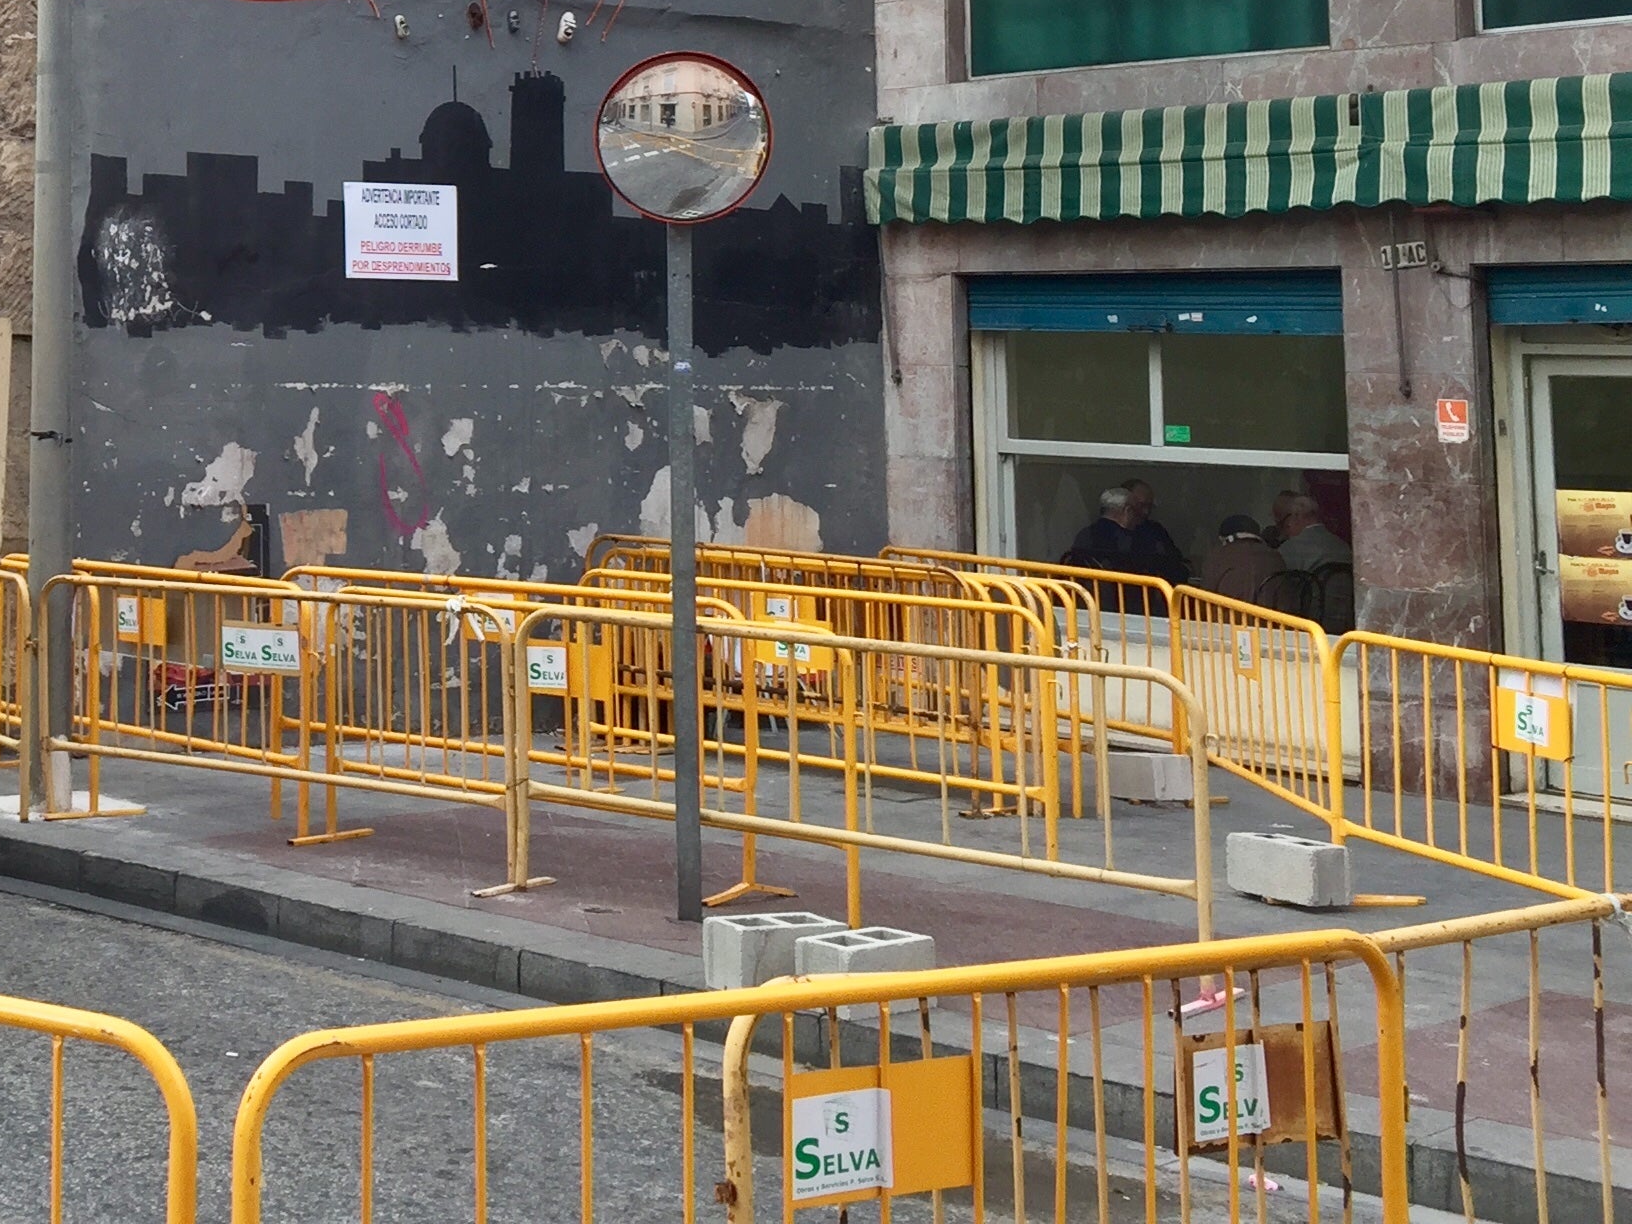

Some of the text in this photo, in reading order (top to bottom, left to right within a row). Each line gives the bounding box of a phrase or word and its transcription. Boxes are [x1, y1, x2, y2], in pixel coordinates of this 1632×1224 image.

[361, 188, 440, 206] ADVERTENCIA IMPORTANTE
[374, 214, 428, 230] ACCESO CORTADO
[360, 240, 443, 254] PELIGRO DERRUMBE
[352, 260, 451, 272] POR DESPRENDIMIENTOS
[224, 641, 258, 661] SELVA
[261, 644, 297, 663] SELVA
[546, 654, 554, 664] S
[835, 1111, 850, 1134] S
[795, 1137, 881, 1181] SELVA
